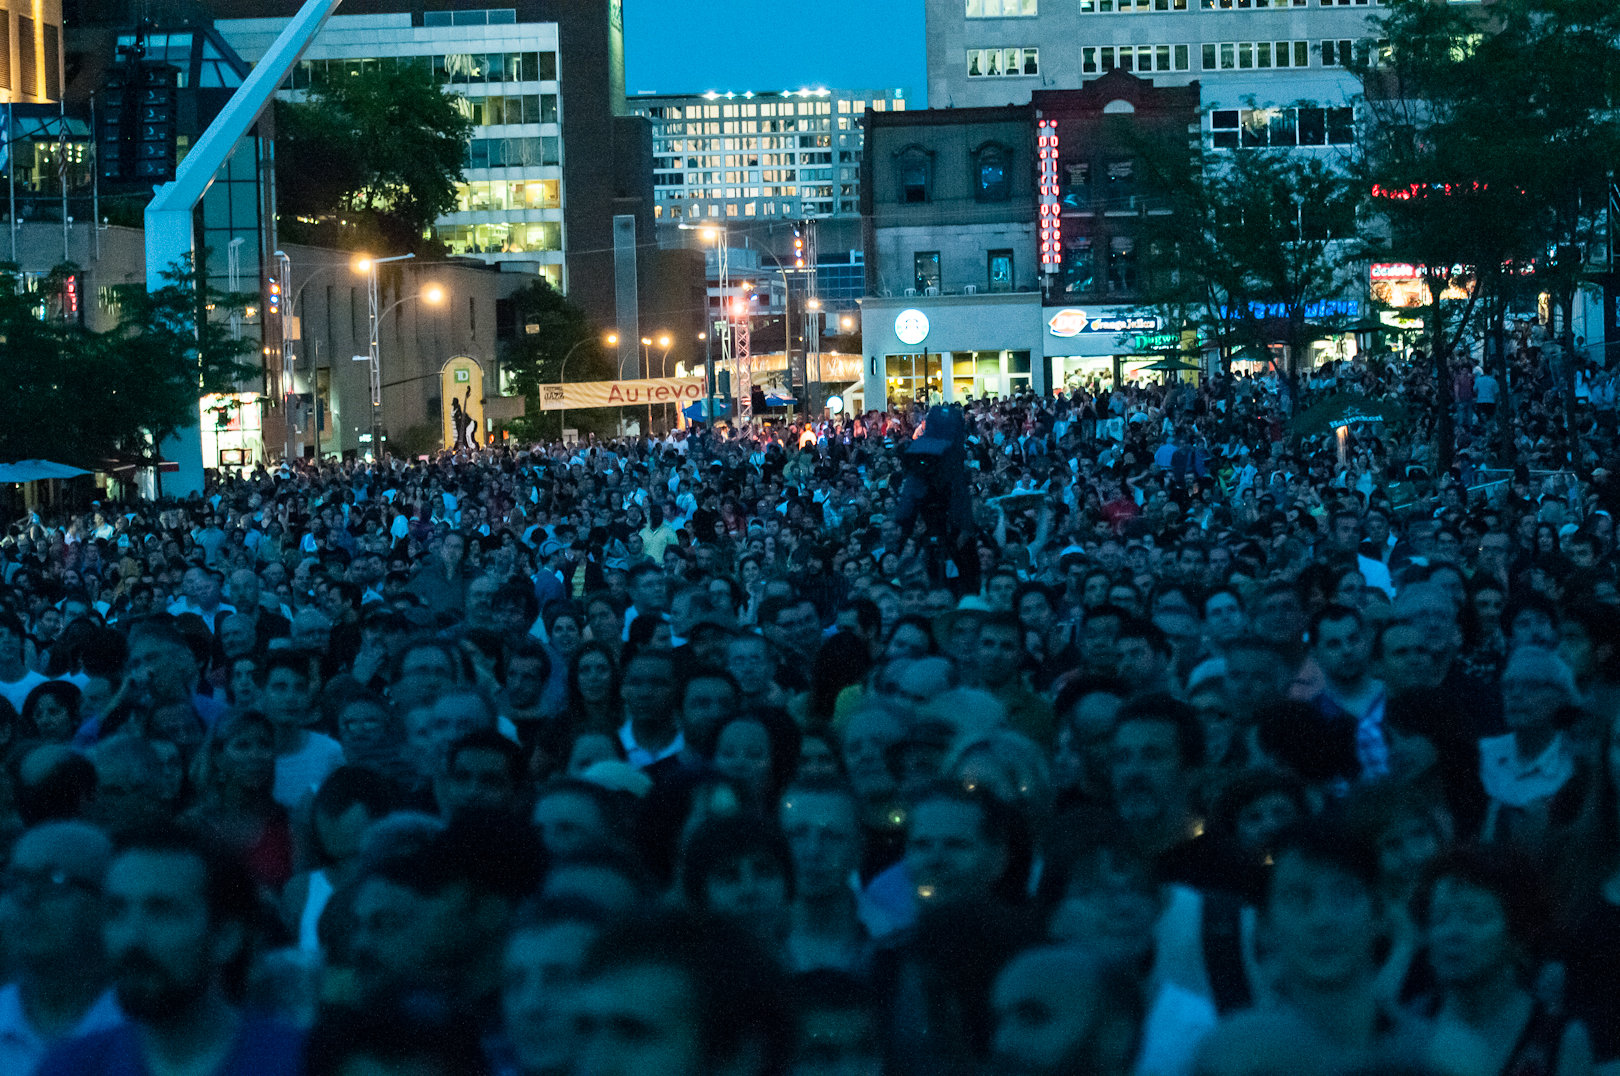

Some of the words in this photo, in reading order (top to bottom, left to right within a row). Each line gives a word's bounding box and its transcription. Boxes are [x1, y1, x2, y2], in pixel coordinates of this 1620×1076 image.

[1038, 135, 1049, 196] Dairy
[1050, 135, 1060, 196] Dairy
[1040, 203, 1051, 264] Queen
[1052, 202, 1062, 264] Queen
[455, 370, 469, 381] TD
[608, 384, 639, 403] Au
[647, 378, 706, 401] revoi
[1329, 414, 1383, 428] Heineken
